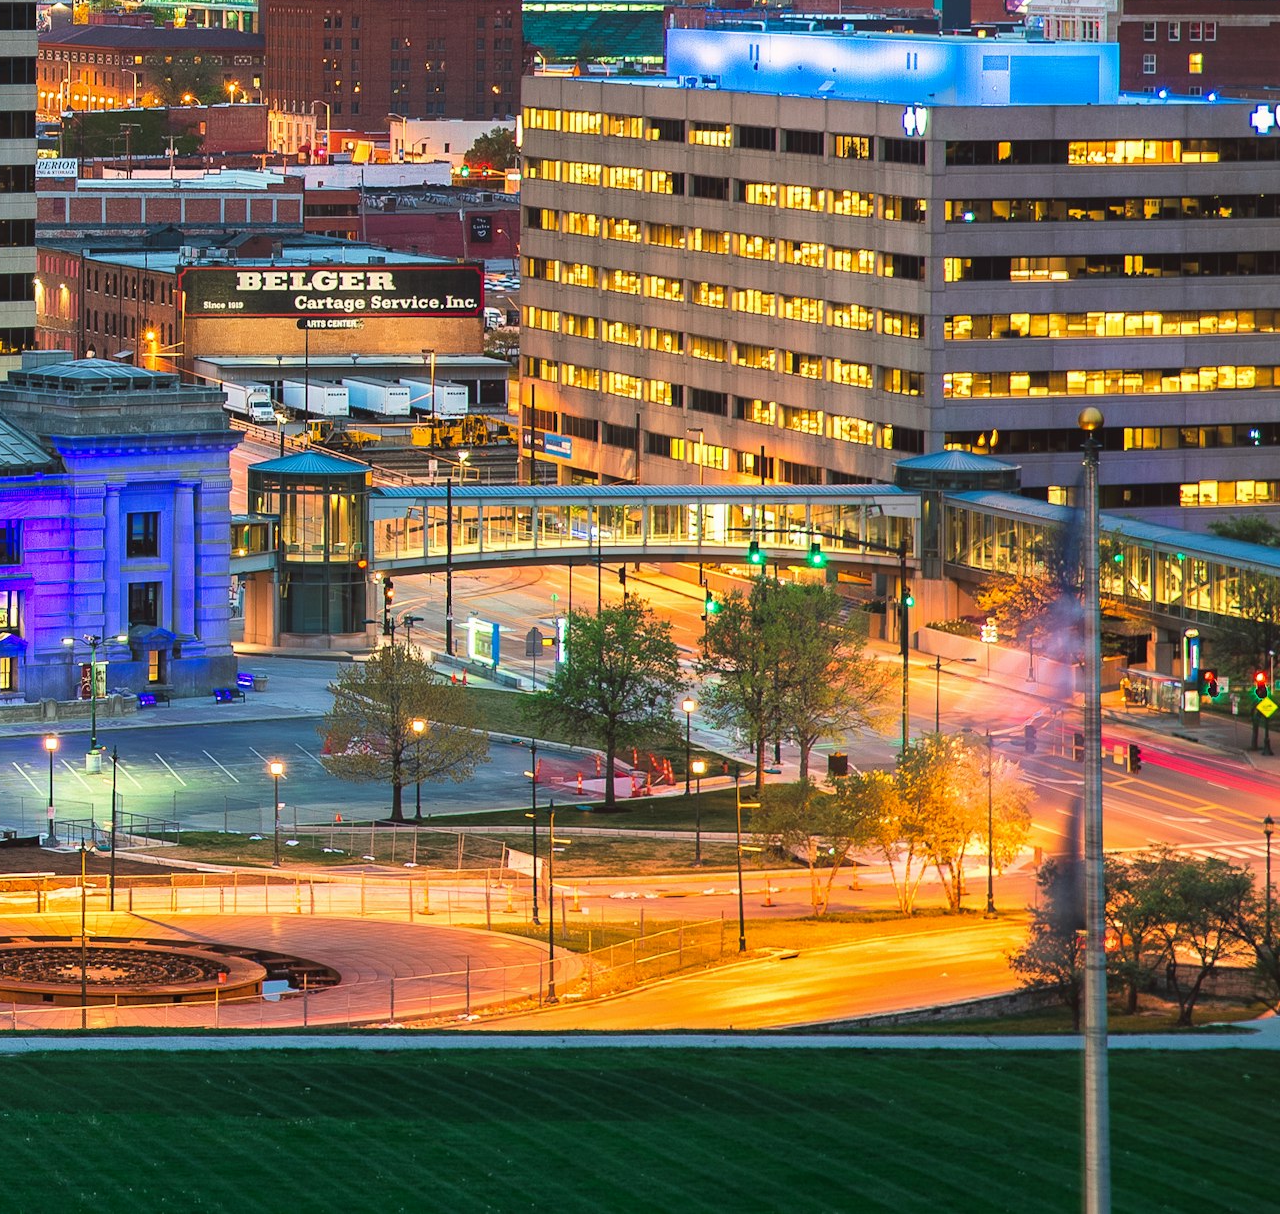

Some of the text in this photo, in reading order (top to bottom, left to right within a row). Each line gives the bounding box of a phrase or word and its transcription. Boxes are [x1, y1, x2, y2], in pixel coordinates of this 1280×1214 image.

[236, 270, 397, 292] BELGER
[203, 301, 244, 310] Since 1919
[294, 295, 366, 312] Cartage
